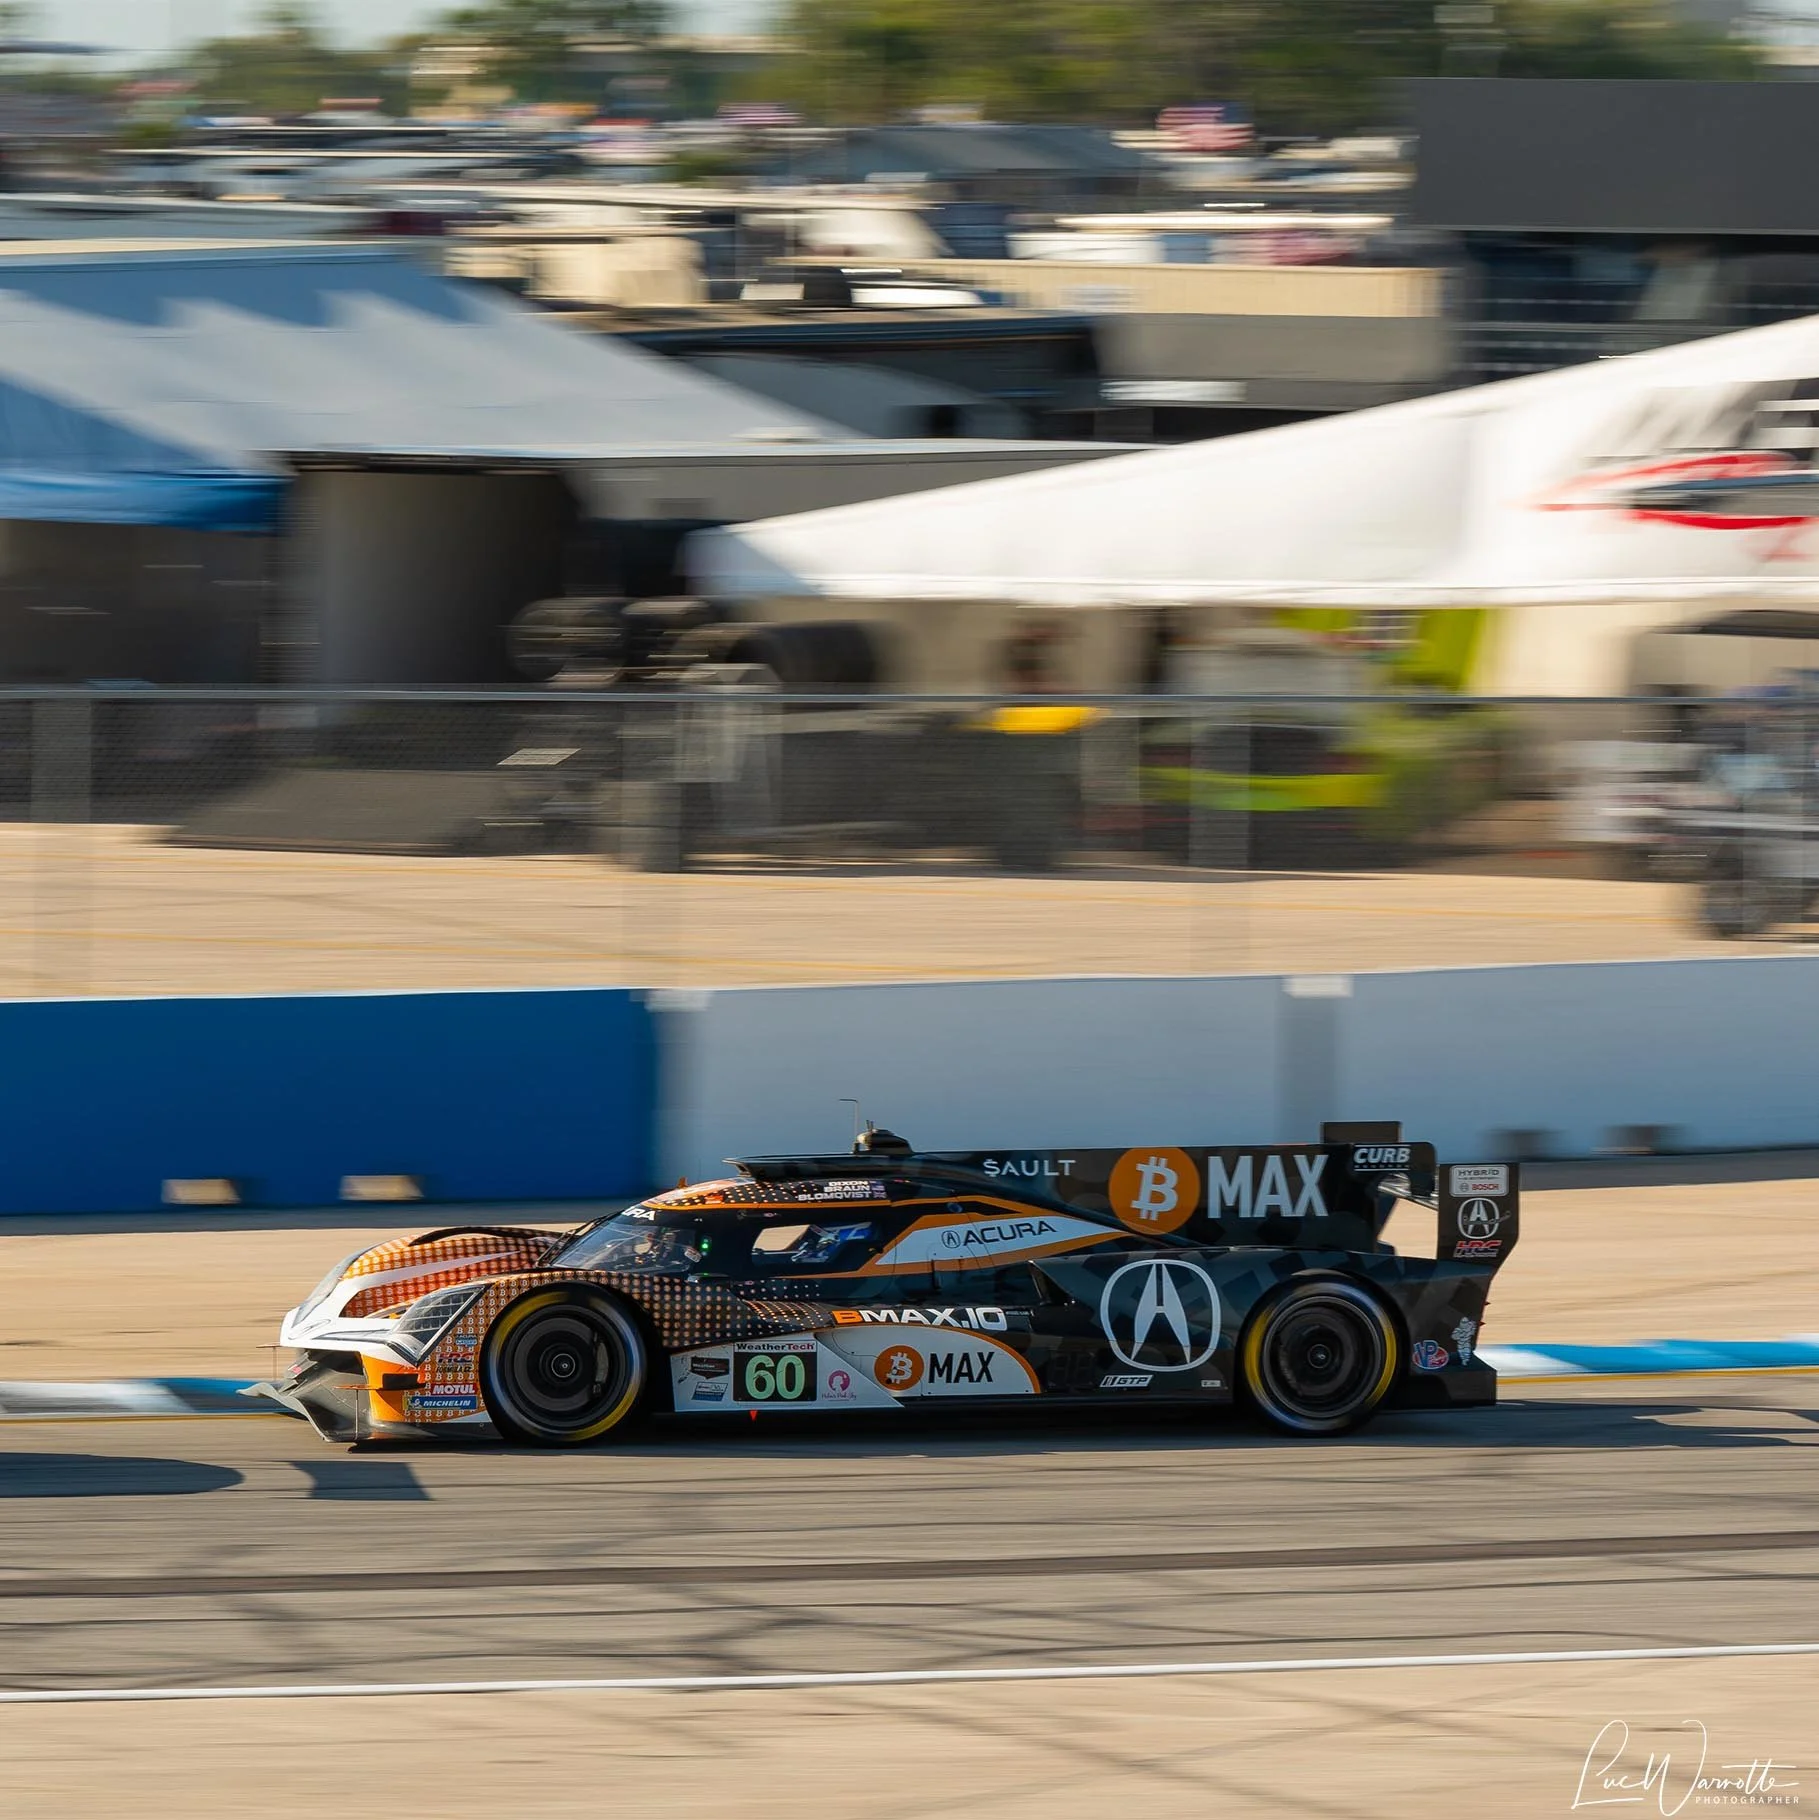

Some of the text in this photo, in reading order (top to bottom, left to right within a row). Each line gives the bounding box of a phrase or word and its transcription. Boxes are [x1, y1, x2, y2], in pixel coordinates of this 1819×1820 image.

[1353, 1148, 1411, 1164] CURB
[1458, 1169, 1500, 1177] HYBRID
[823, 1185, 870, 1193] BRAUN
[1207, 1154, 1329, 1219] MAX
[1471, 1183, 1500, 1191] BOSCH
[797, 1191, 872, 1201] BLOMQVIST
[962, 1220, 1057, 1246] ACURA
[831, 1307, 1008, 1331] BMAX.IO
[736, 1343, 815, 1351] WeatherTech
[928, 1351, 995, 1384] MAX
[745, 1354, 805, 1400] 60
[1117, 1377, 1148, 1385] GTP
[432, 1384, 476, 1394] MOTUL
